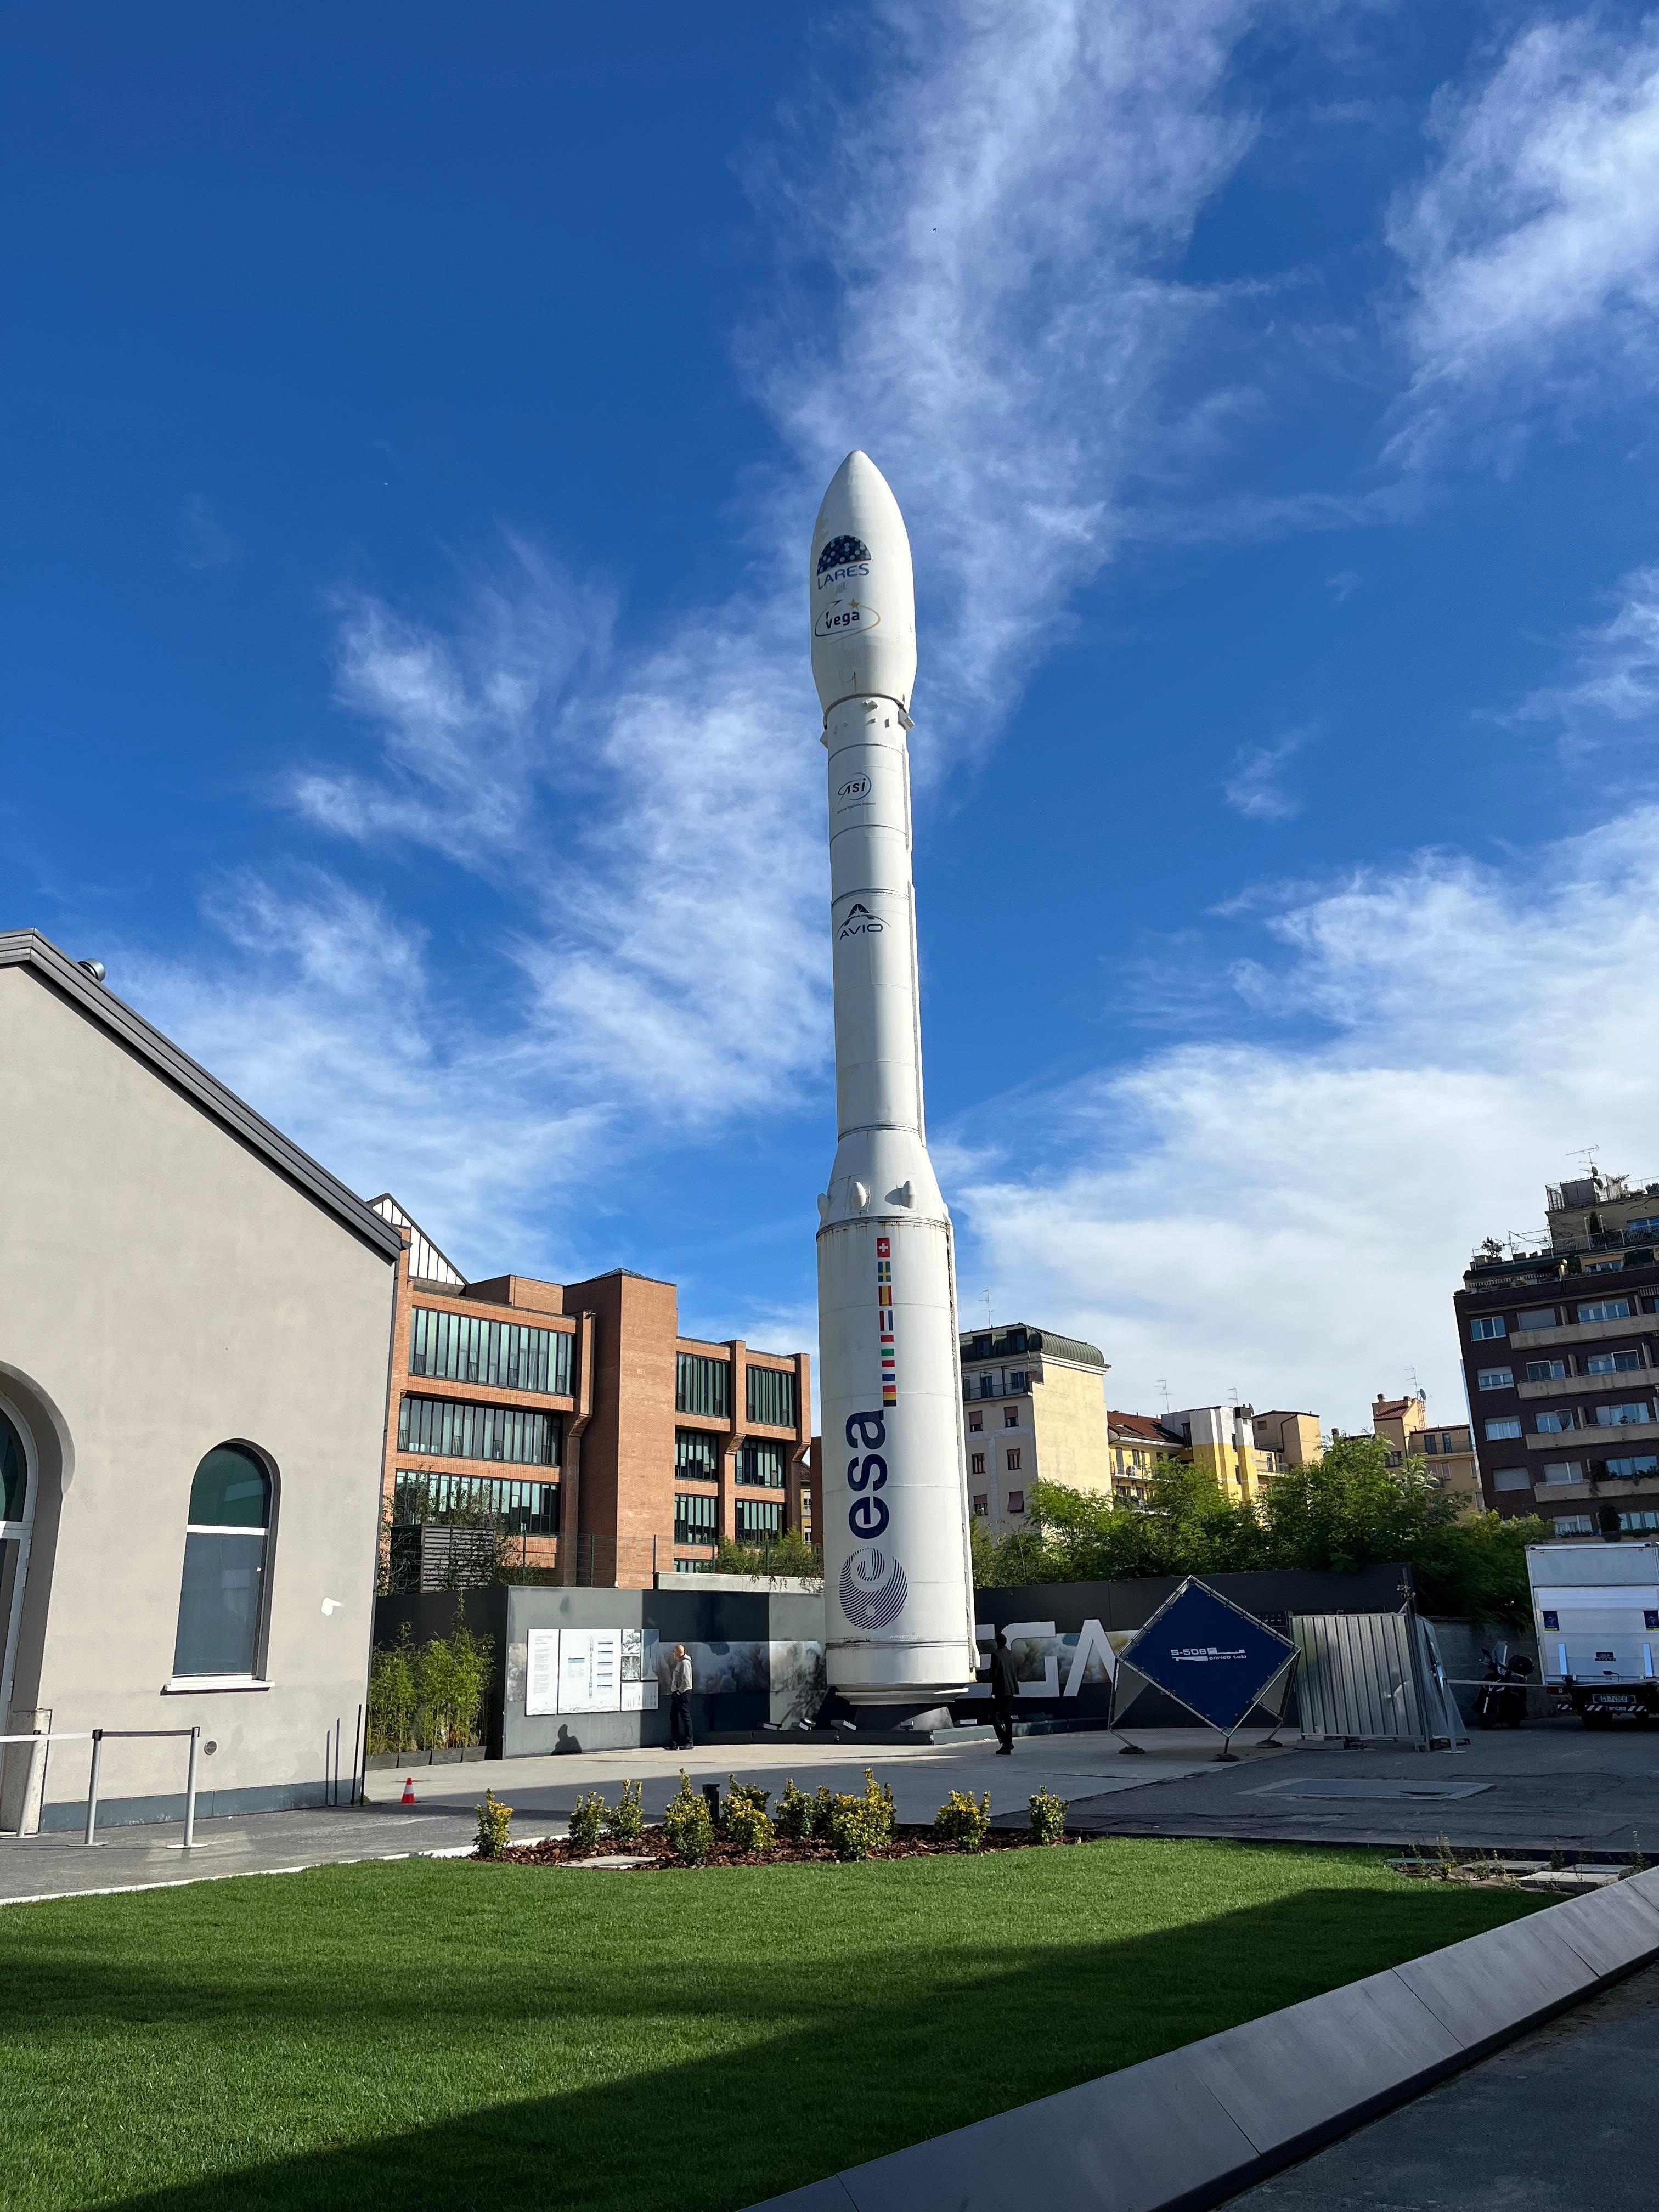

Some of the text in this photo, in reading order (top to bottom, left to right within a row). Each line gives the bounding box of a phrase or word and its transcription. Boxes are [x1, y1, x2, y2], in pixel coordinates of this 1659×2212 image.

[817, 563, 870, 590] LARES
[826, 611, 860, 629] vega
[839, 924, 883, 941] AVIO
[845, 1409, 890, 1539] esa
